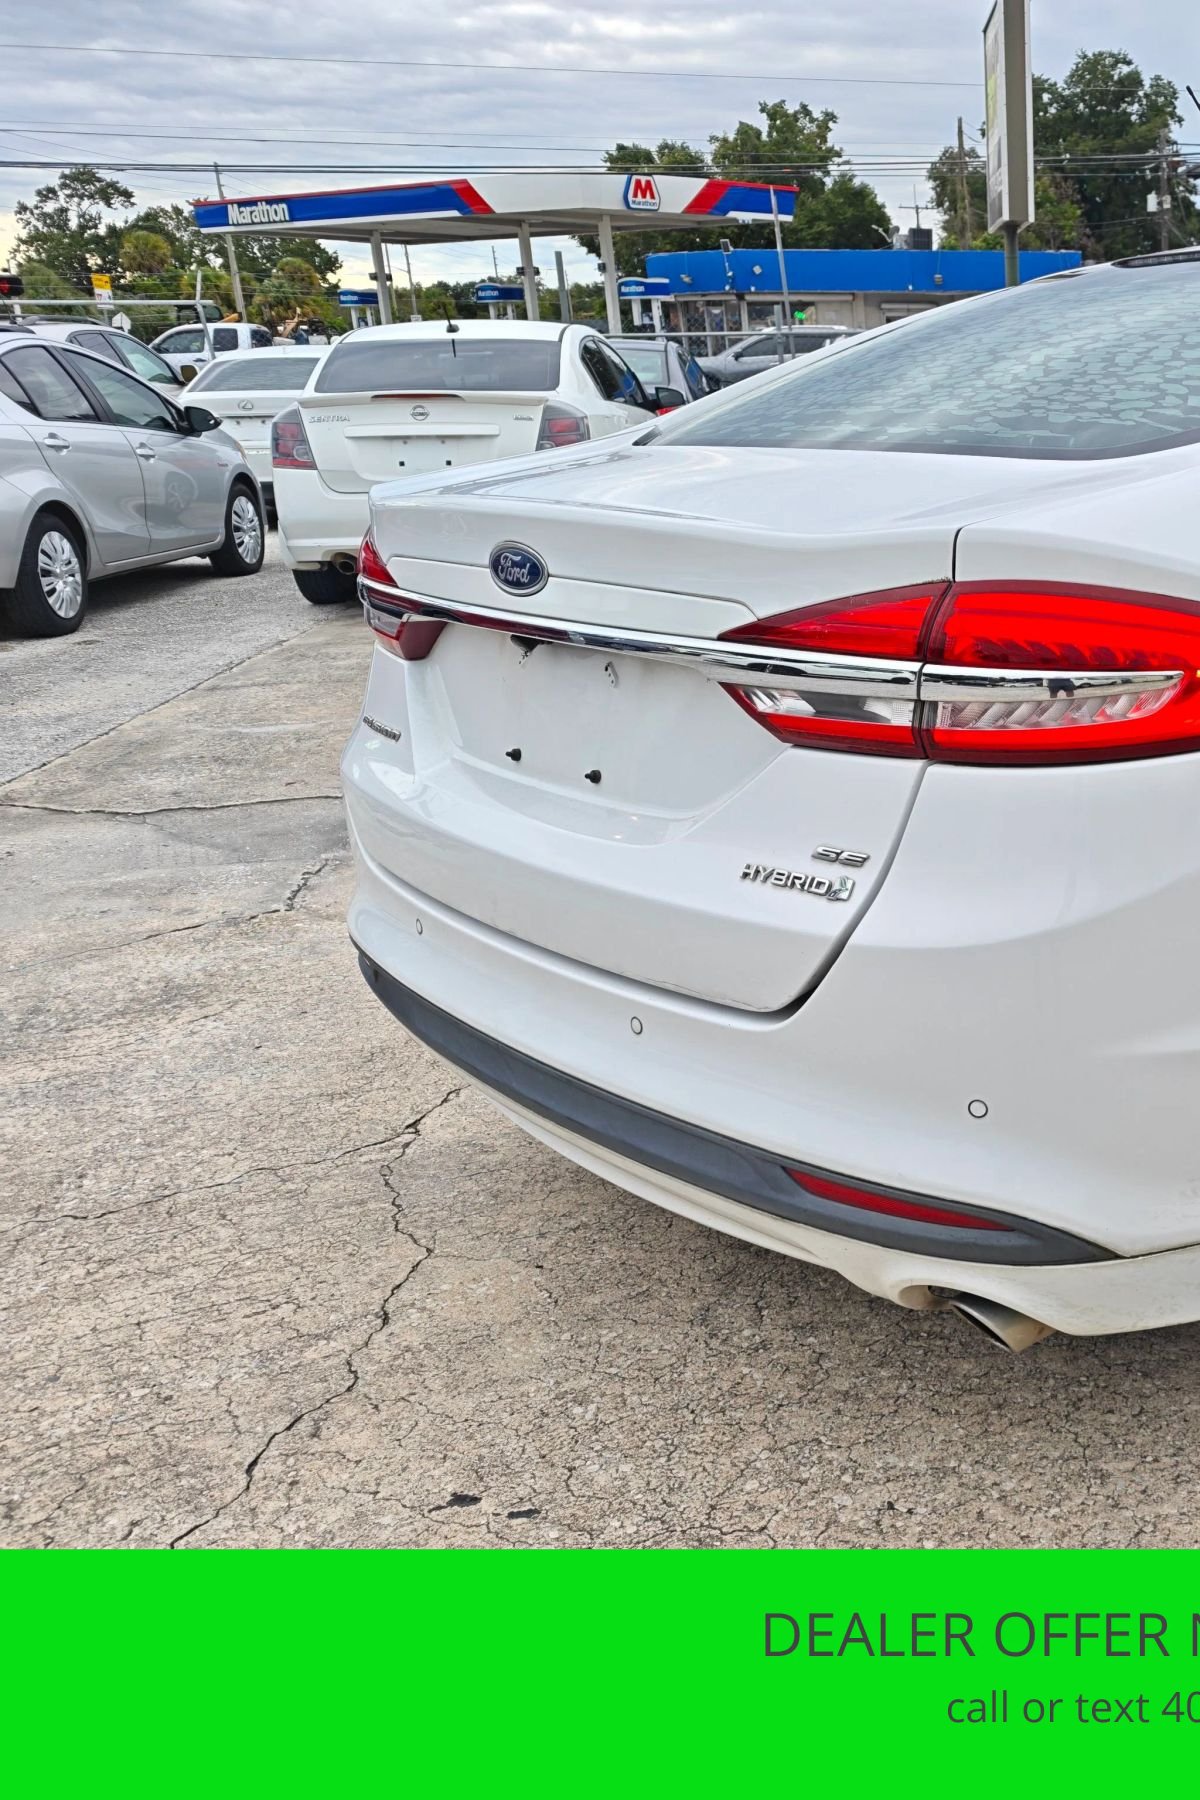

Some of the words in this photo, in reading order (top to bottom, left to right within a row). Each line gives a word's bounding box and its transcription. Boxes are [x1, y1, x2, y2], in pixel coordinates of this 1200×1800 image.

[632, 178, 656, 200] M
[227, 201, 290, 225] Marathon
[631, 199, 657, 208] Marathon
[309, 415, 351, 424] SENTRA
[498, 552, 530, 583] Ford
[811, 845, 871, 868] SE
[739, 862, 834, 897] HYBRID
